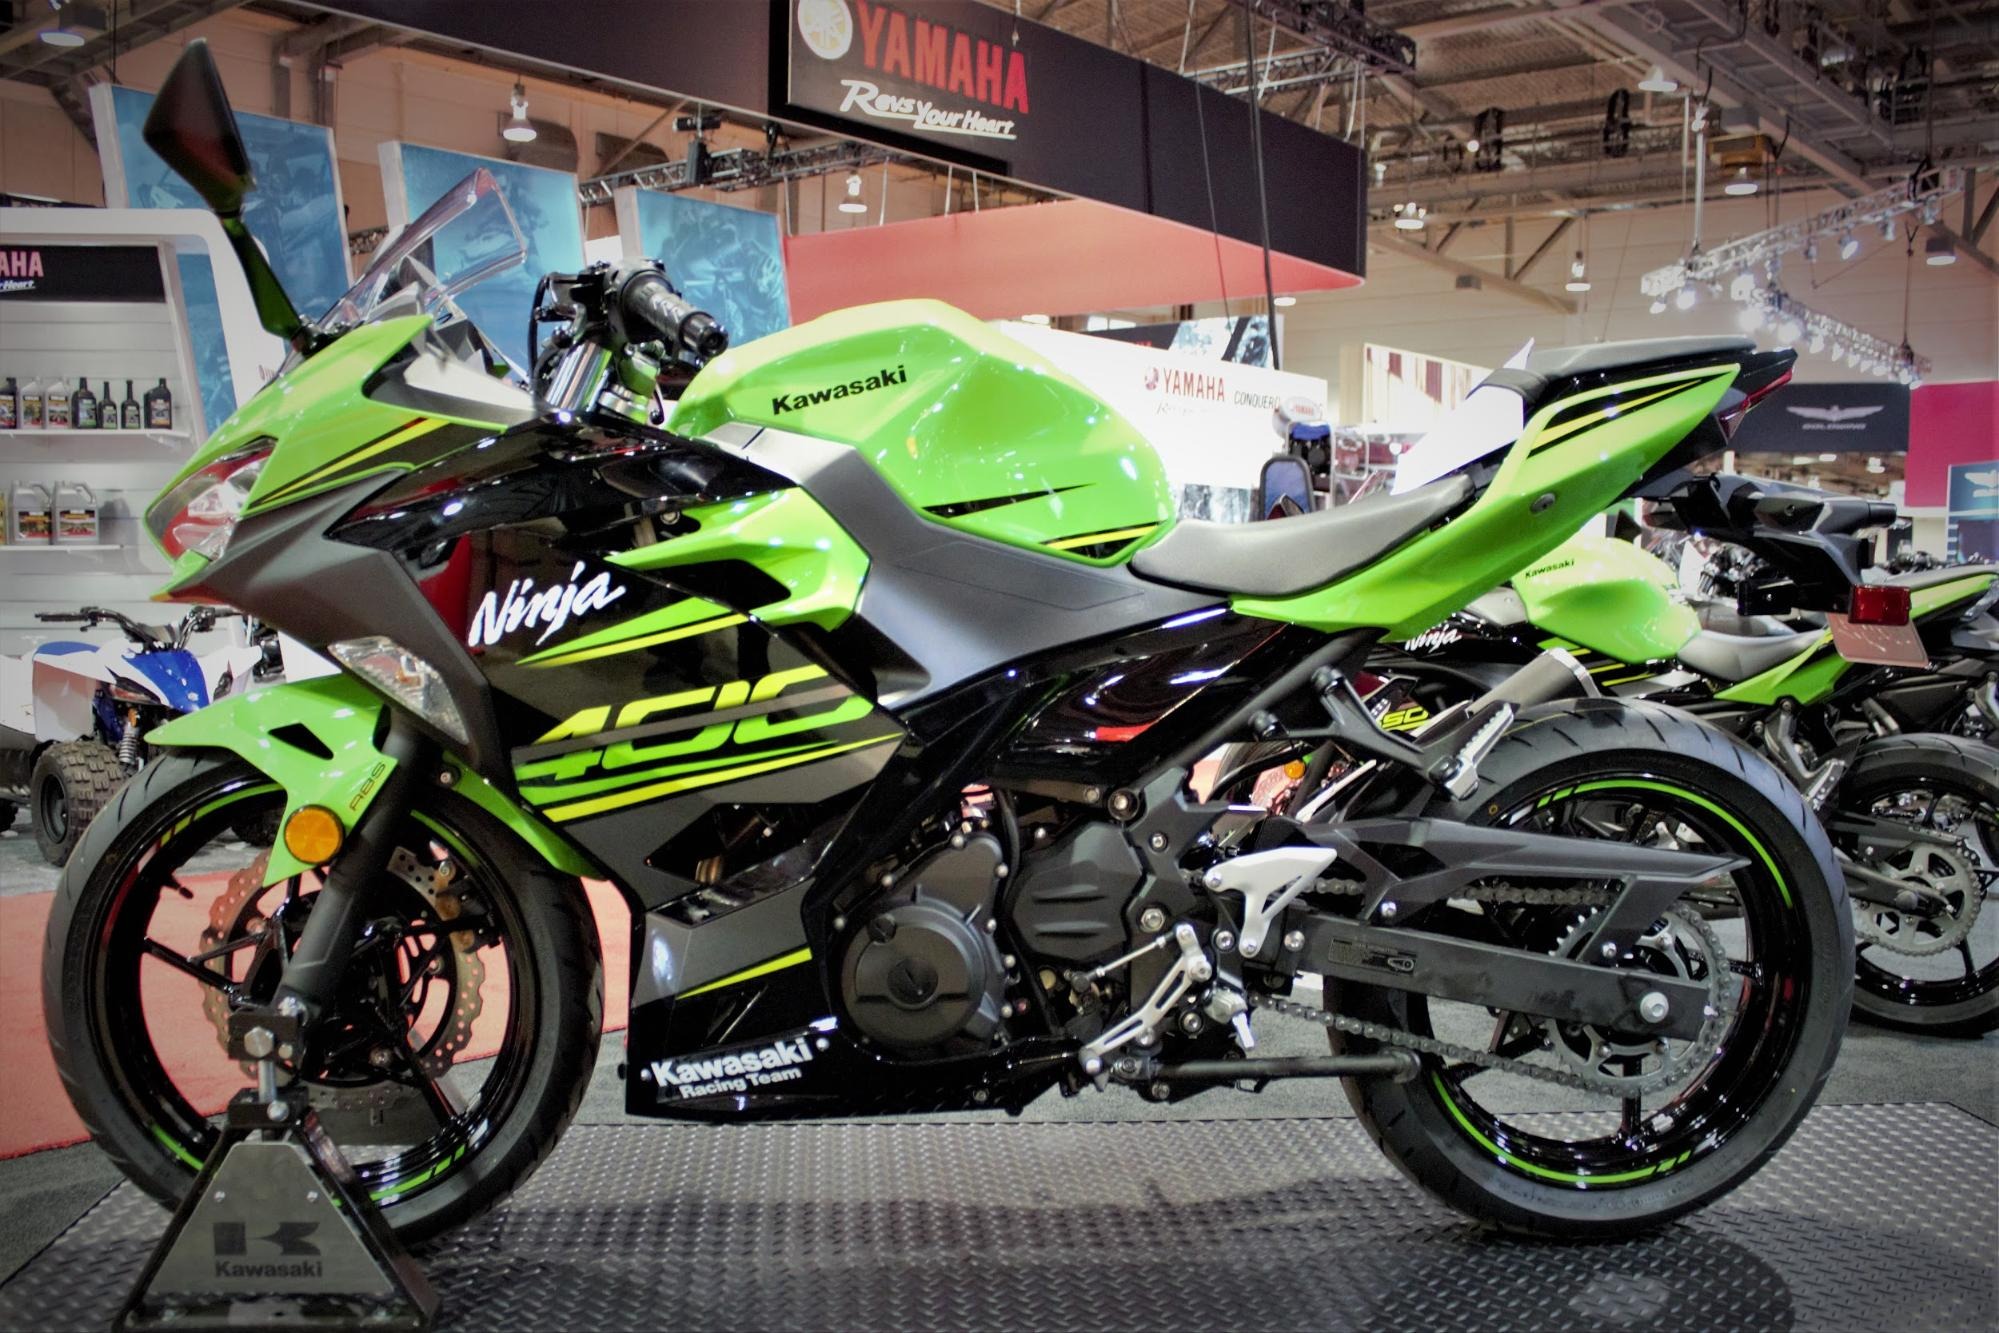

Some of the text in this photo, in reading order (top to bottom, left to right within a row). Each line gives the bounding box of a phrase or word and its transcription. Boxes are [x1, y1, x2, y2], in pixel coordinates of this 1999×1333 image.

[857, 0, 1029, 114] YAMAHA
[840, 79, 916, 119] Revs
[961, 109, 1017, 140] Heart
[772, 365, 907, 415] Kawasaki
[1163, 367, 1225, 402] YAMAHA
[1525, 558, 1575, 579] Kawasaki
[468, 560, 627, 647] Ninja
[1404, 624, 1462, 653] Ninja
[651, 1037, 813, 1087] Kawasaki
[679, 1067, 802, 1099] Racing Team
[215, 1260, 322, 1277] Kawasaki
